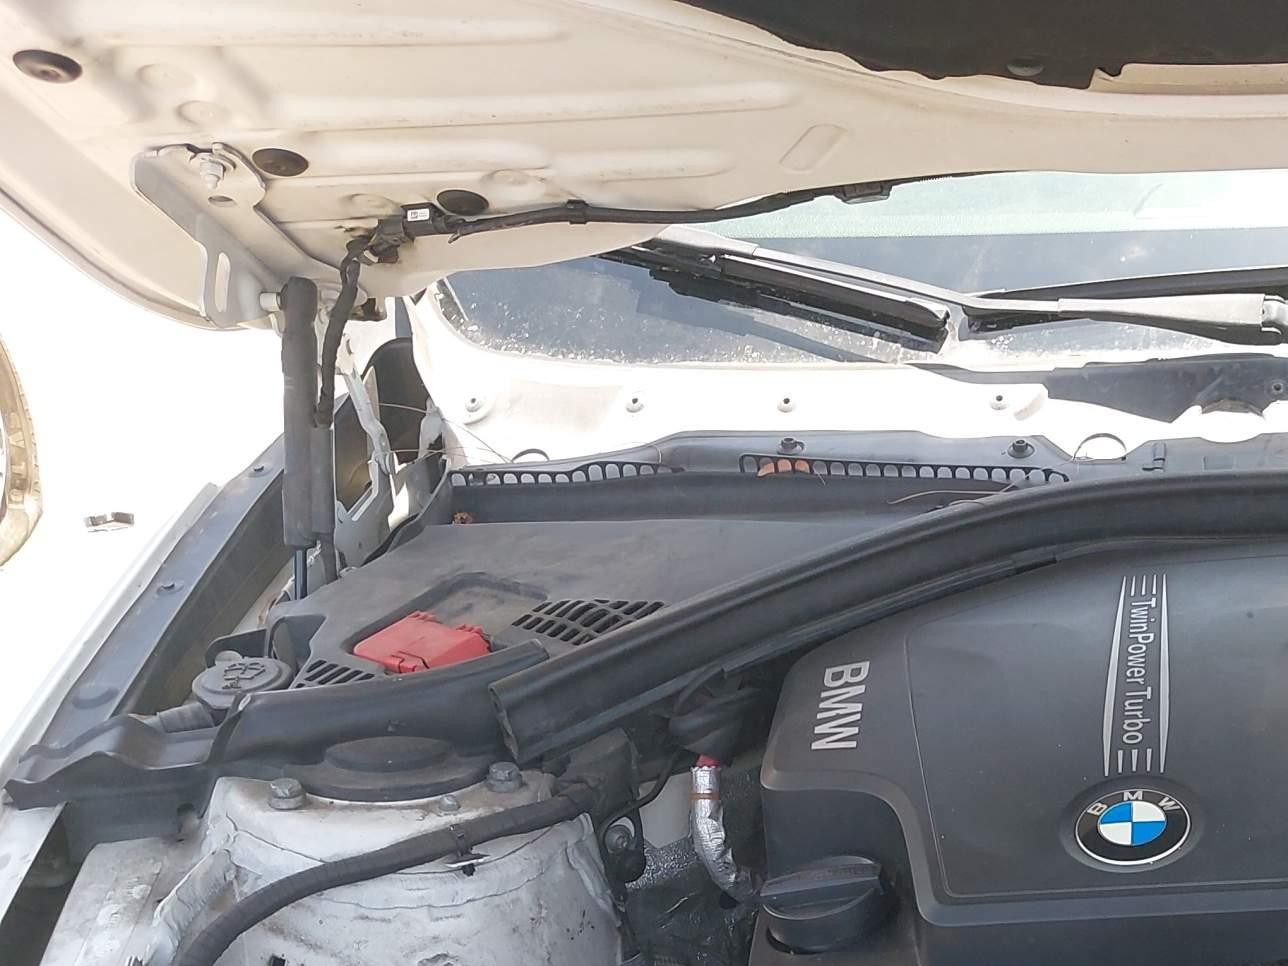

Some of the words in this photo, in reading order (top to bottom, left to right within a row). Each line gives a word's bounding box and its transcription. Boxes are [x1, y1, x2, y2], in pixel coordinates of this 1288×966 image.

[1126, 596, 1158, 685] TwinPower
[811, 660, 870, 750] BMW
[1123, 687, 1151, 744] Turbo
[1087, 790, 1181, 815] BMW
